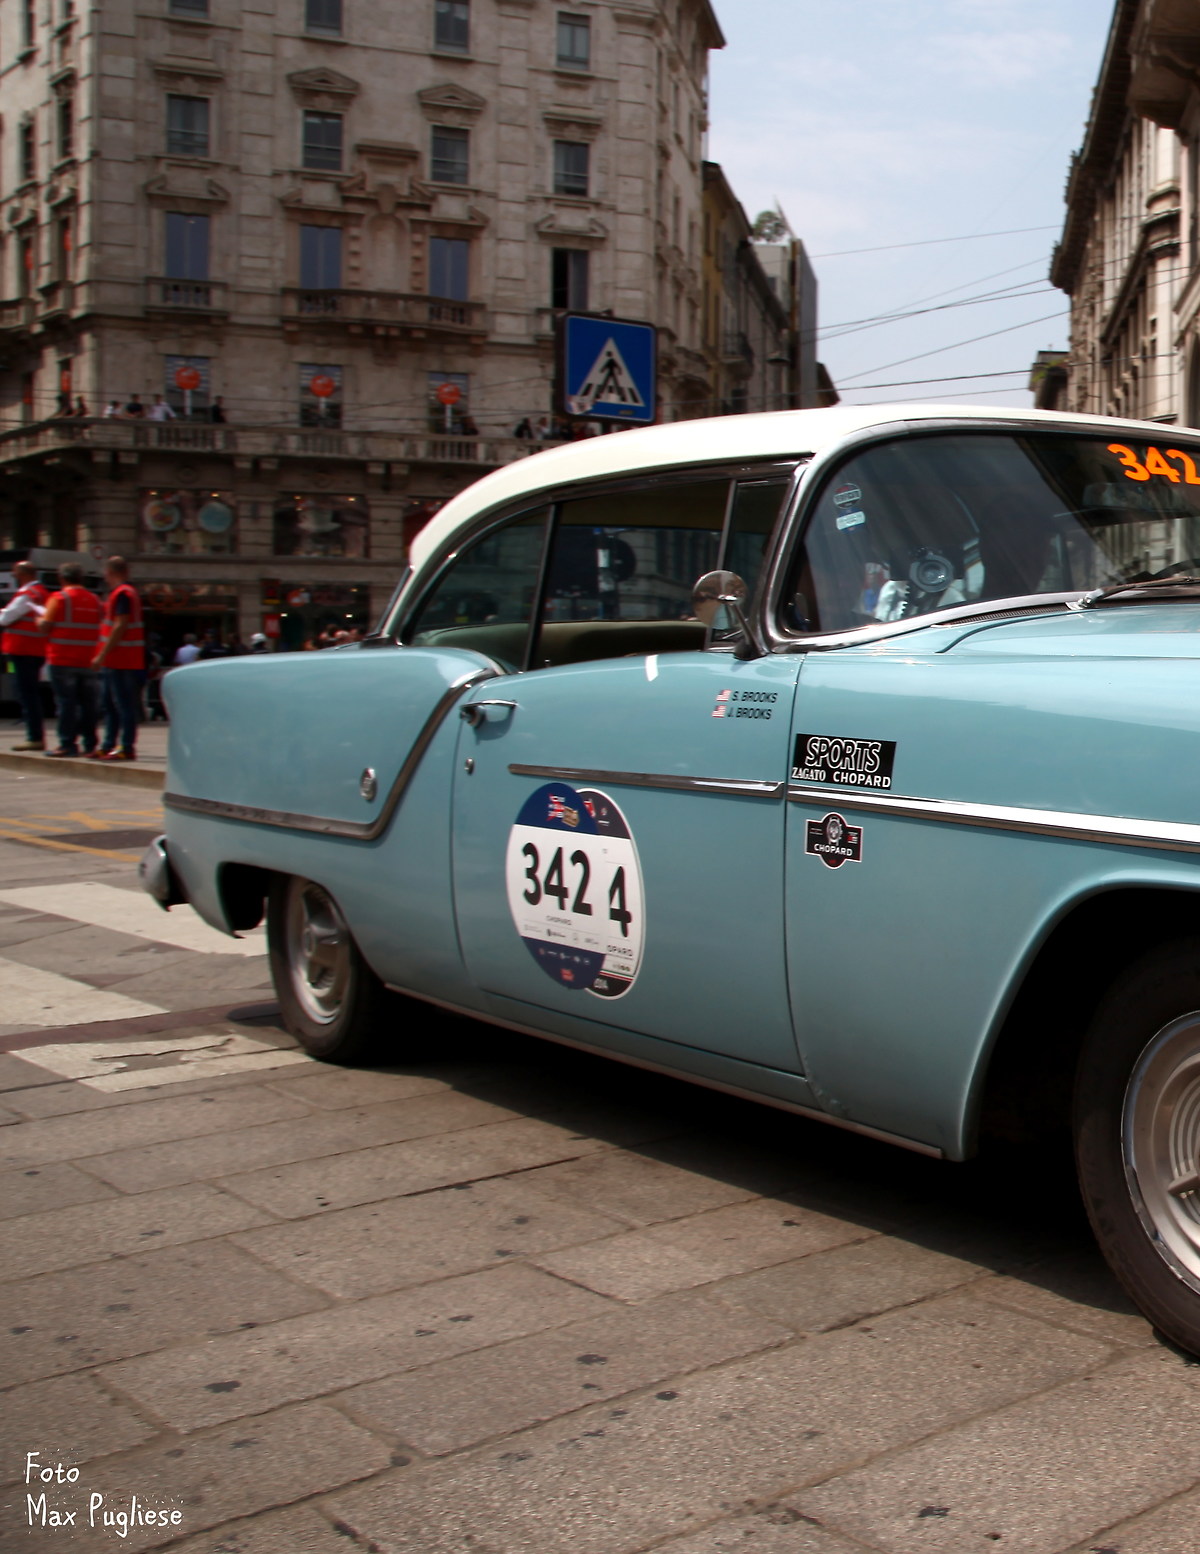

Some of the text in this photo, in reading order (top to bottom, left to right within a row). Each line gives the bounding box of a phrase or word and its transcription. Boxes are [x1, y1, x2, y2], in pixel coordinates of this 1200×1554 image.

[731, 690, 778, 704] S. BROOKS
[727, 707, 772, 720] J. BROOKS
[805, 736, 882, 773] SPORTS
[792, 767, 891, 788] ZAGATO CHOPARD
[814, 843, 853, 856] CHOPARD
[522, 842, 593, 916] 342
[609, 866, 633, 938] 4
